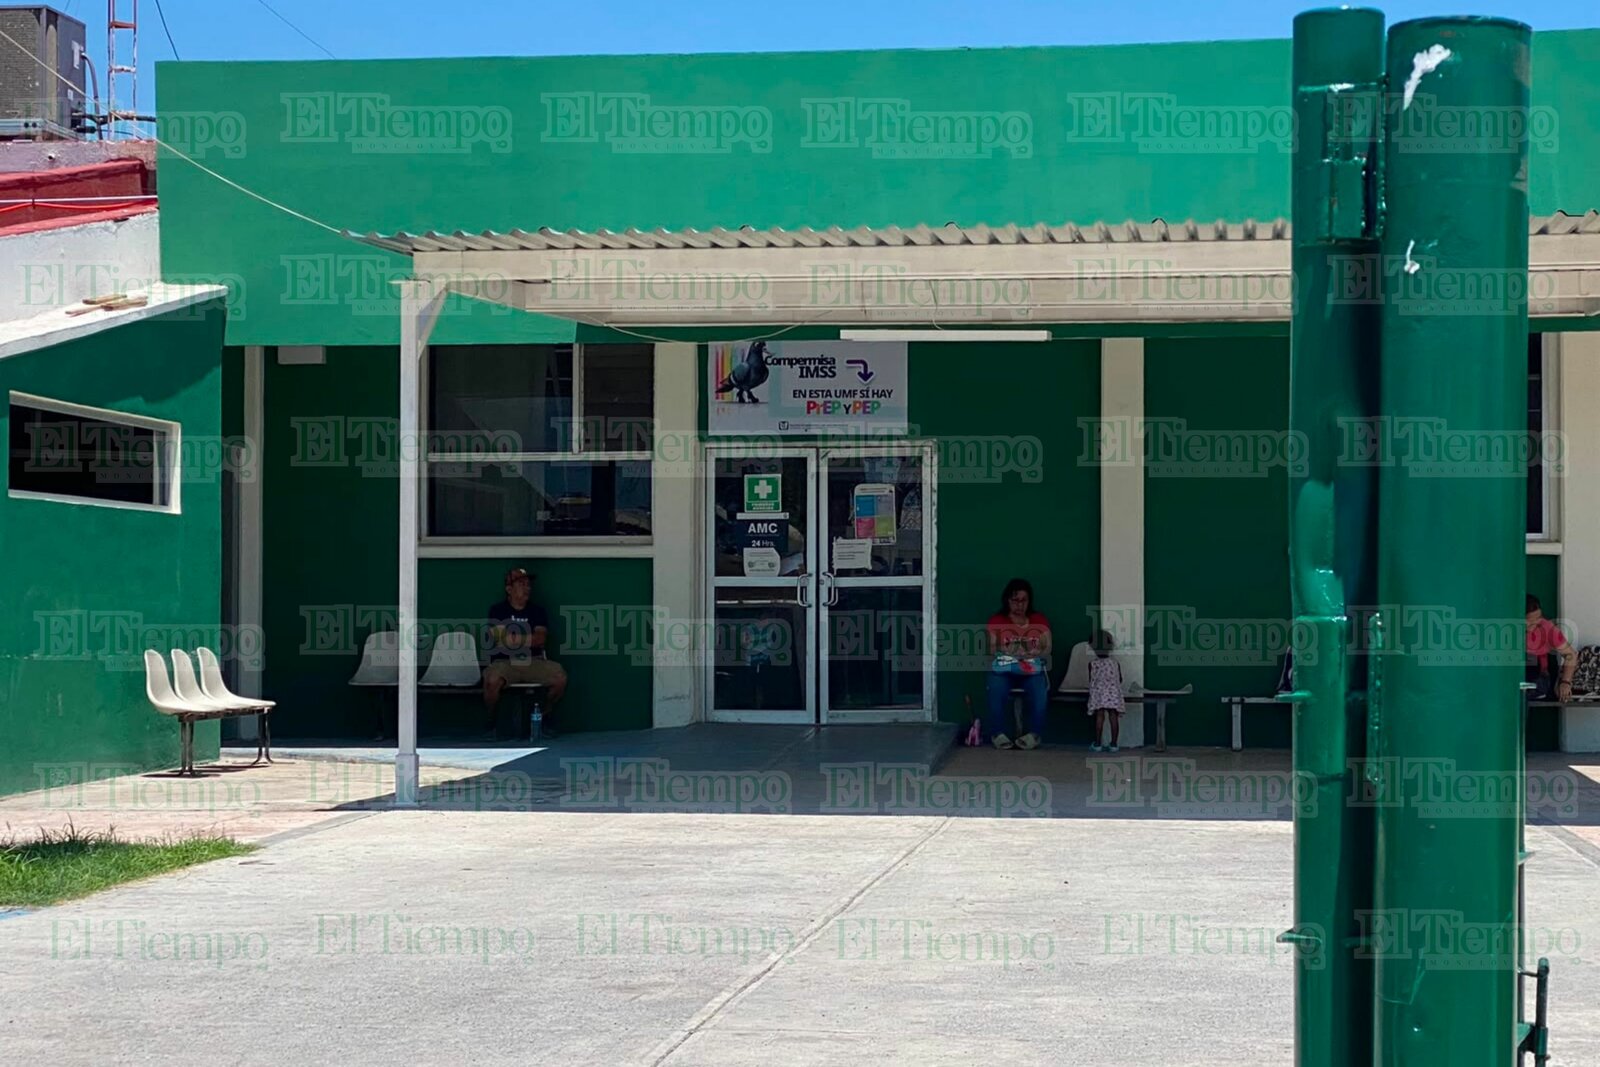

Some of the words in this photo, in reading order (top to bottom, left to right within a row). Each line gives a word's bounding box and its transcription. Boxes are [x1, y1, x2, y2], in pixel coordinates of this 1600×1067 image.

[764, 355, 835, 368] Compermisa
[799, 366, 836, 378] IMSS
[793, 389, 807, 398] EN
[809, 389, 832, 398] ESTA
[834, 389, 858, 398] UMF
[860, 387, 870, 398] SÍ
[872, 389, 893, 398] HAY
[807, 401, 841, 414] PrEP
[843, 404, 851, 414] Y
[852, 401, 881, 414] PEP
[748, 523, 777, 533] AMC
